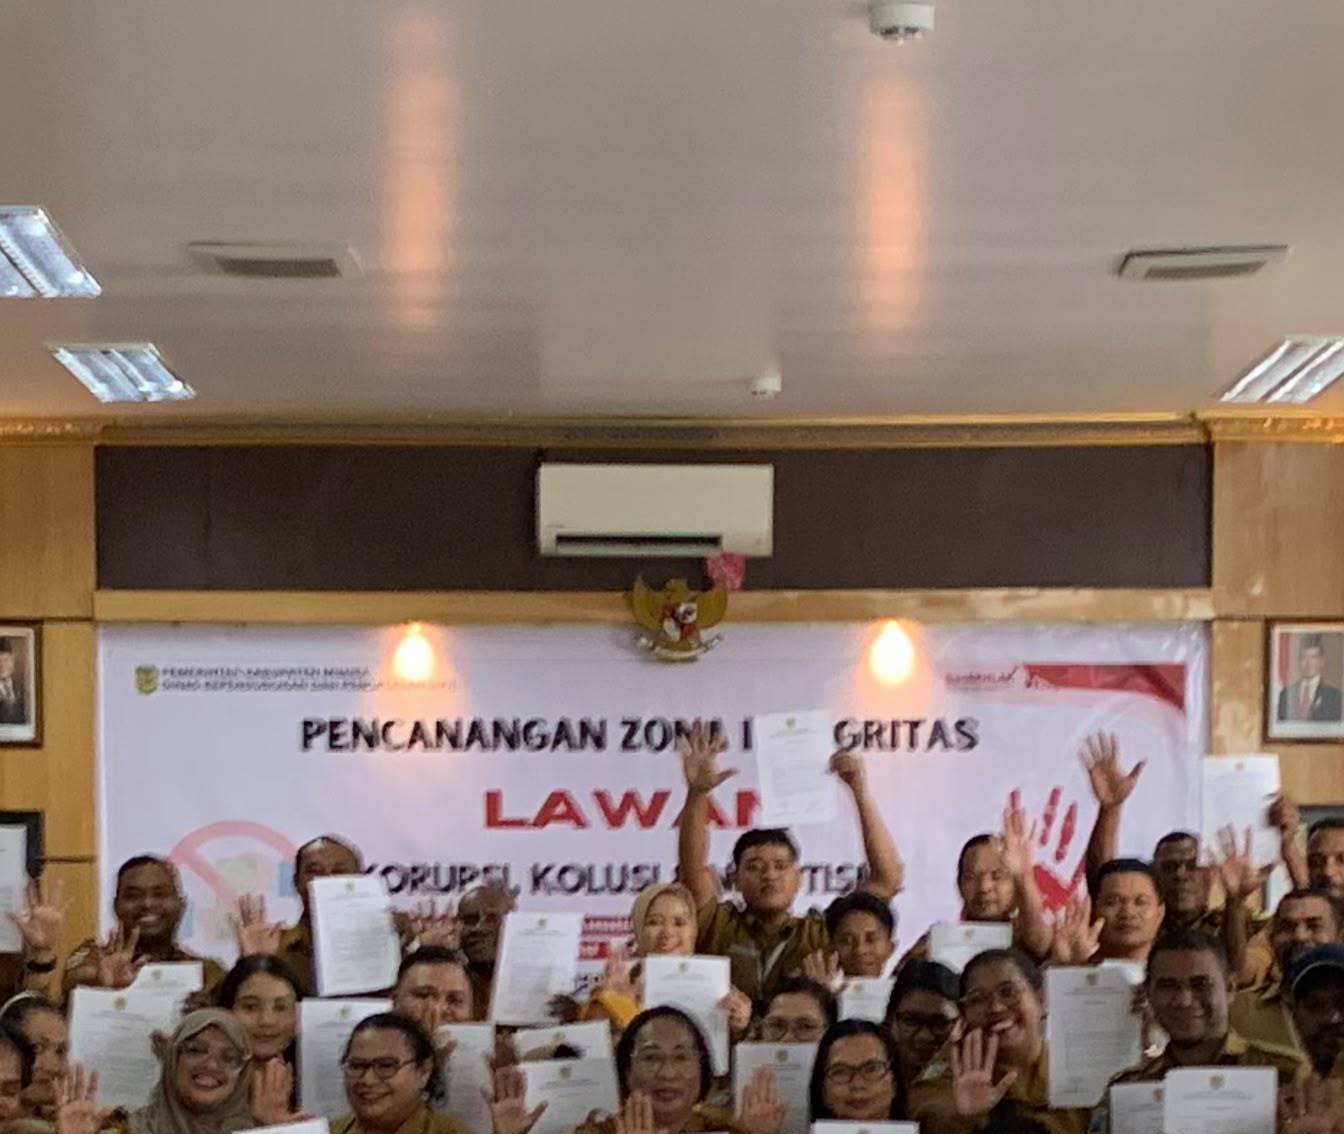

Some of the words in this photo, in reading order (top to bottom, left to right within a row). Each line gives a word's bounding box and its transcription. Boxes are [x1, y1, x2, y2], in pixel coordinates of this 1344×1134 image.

[301, 718, 607, 753] PENCANANGAN
[743, 717, 980, 752] IGRITAS
[363, 861, 523, 898] ORUPSI,
